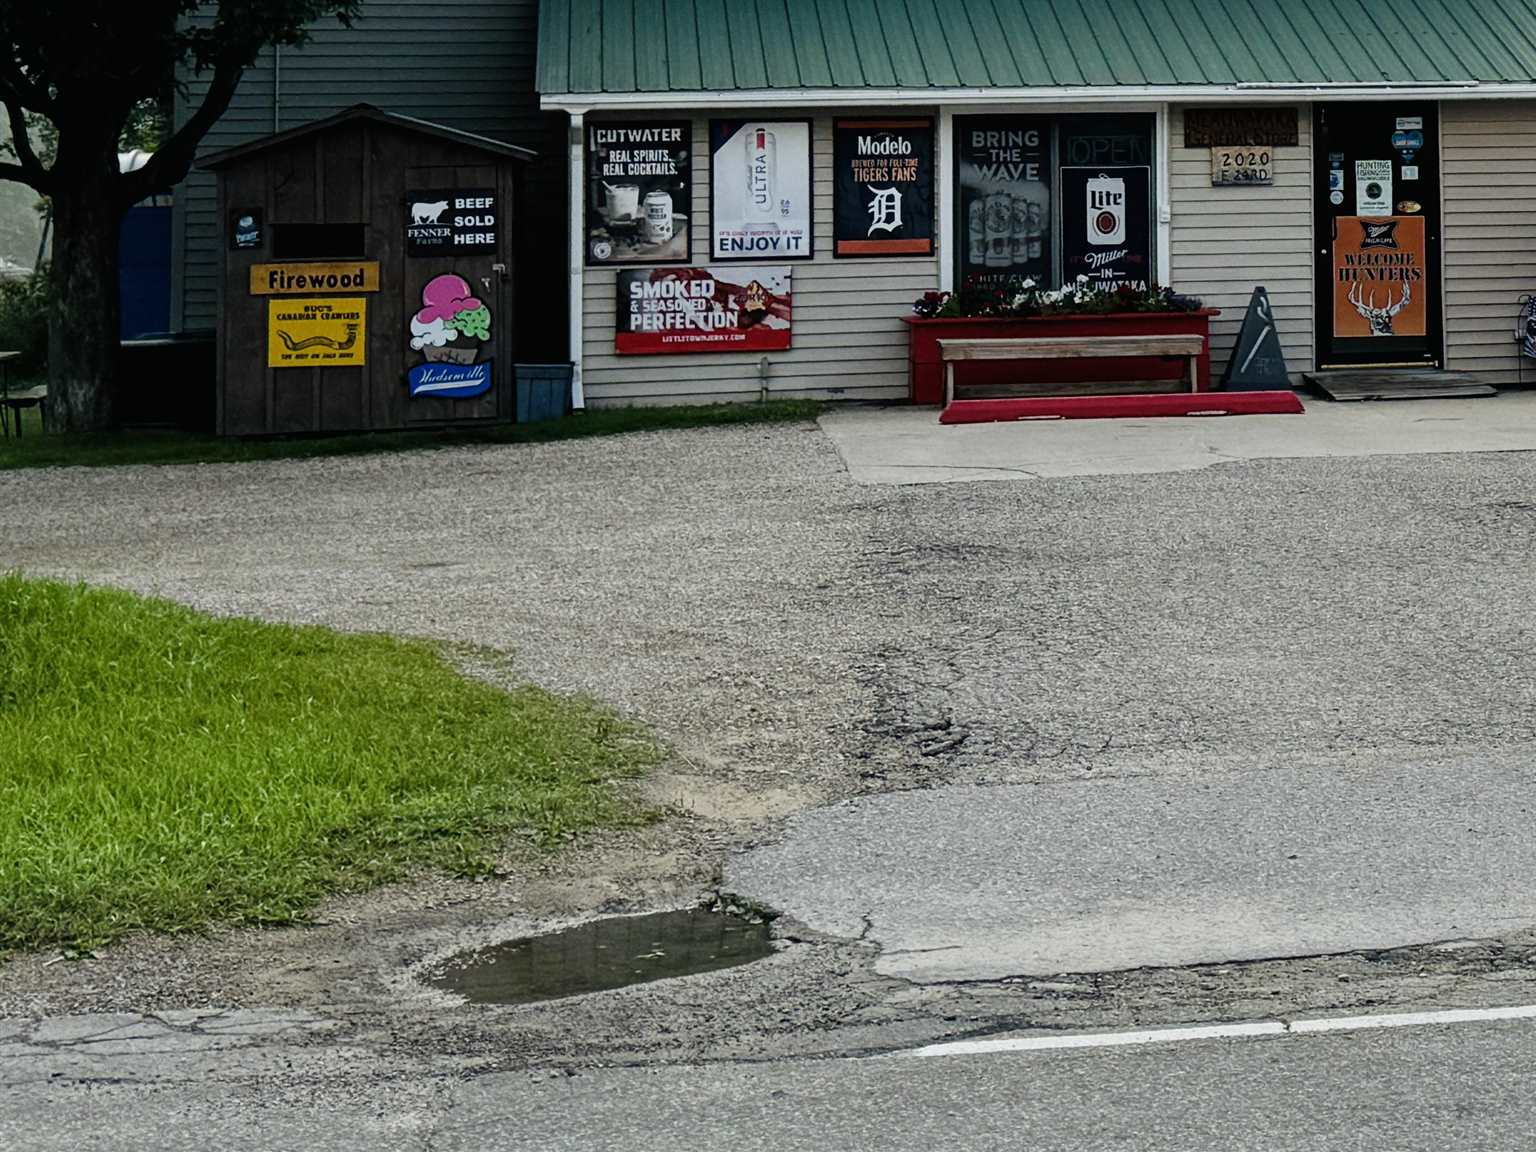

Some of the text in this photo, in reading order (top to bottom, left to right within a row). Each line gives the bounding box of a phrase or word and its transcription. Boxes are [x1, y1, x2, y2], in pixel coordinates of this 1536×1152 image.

[597, 128, 681, 143] CUTWATER
[972, 130, 1039, 147] BRING
[858, 135, 912, 155] Modelo
[1069, 136, 1146, 163] OPEN
[609, 149, 672, 162] REAL SPIRITS.
[989, 148, 1021, 162] THE
[1222, 152, 1269, 166] 2020
[603, 162, 678, 176] REAL COCKTAILS.
[853, 167, 917, 182] TIGERS FANS
[973, 163, 1040, 181] WAVE
[755, 154, 767, 204] ULTRA
[455, 197, 494, 209] BEEF
[1091, 190, 1122, 210] Lite
[454, 215, 495, 227] SOLD
[408, 228, 451, 238] FENNER
[454, 233, 495, 245] HERE
[719, 237, 802, 251] ENJOY IT
[1084, 249, 1128, 269] Miller
[1345, 253, 1415, 266] WELCOME
[269, 268, 364, 289] Firewood
[1100, 268, 1113, 279] IN
[1338, 267, 1421, 281] HUNTERS
[630, 280, 715, 299] SMOKED
[630, 298, 706, 313] & SEASONED
[321, 312, 360, 320] CRAWLERS
[630, 310, 738, 331] PERFECTION
